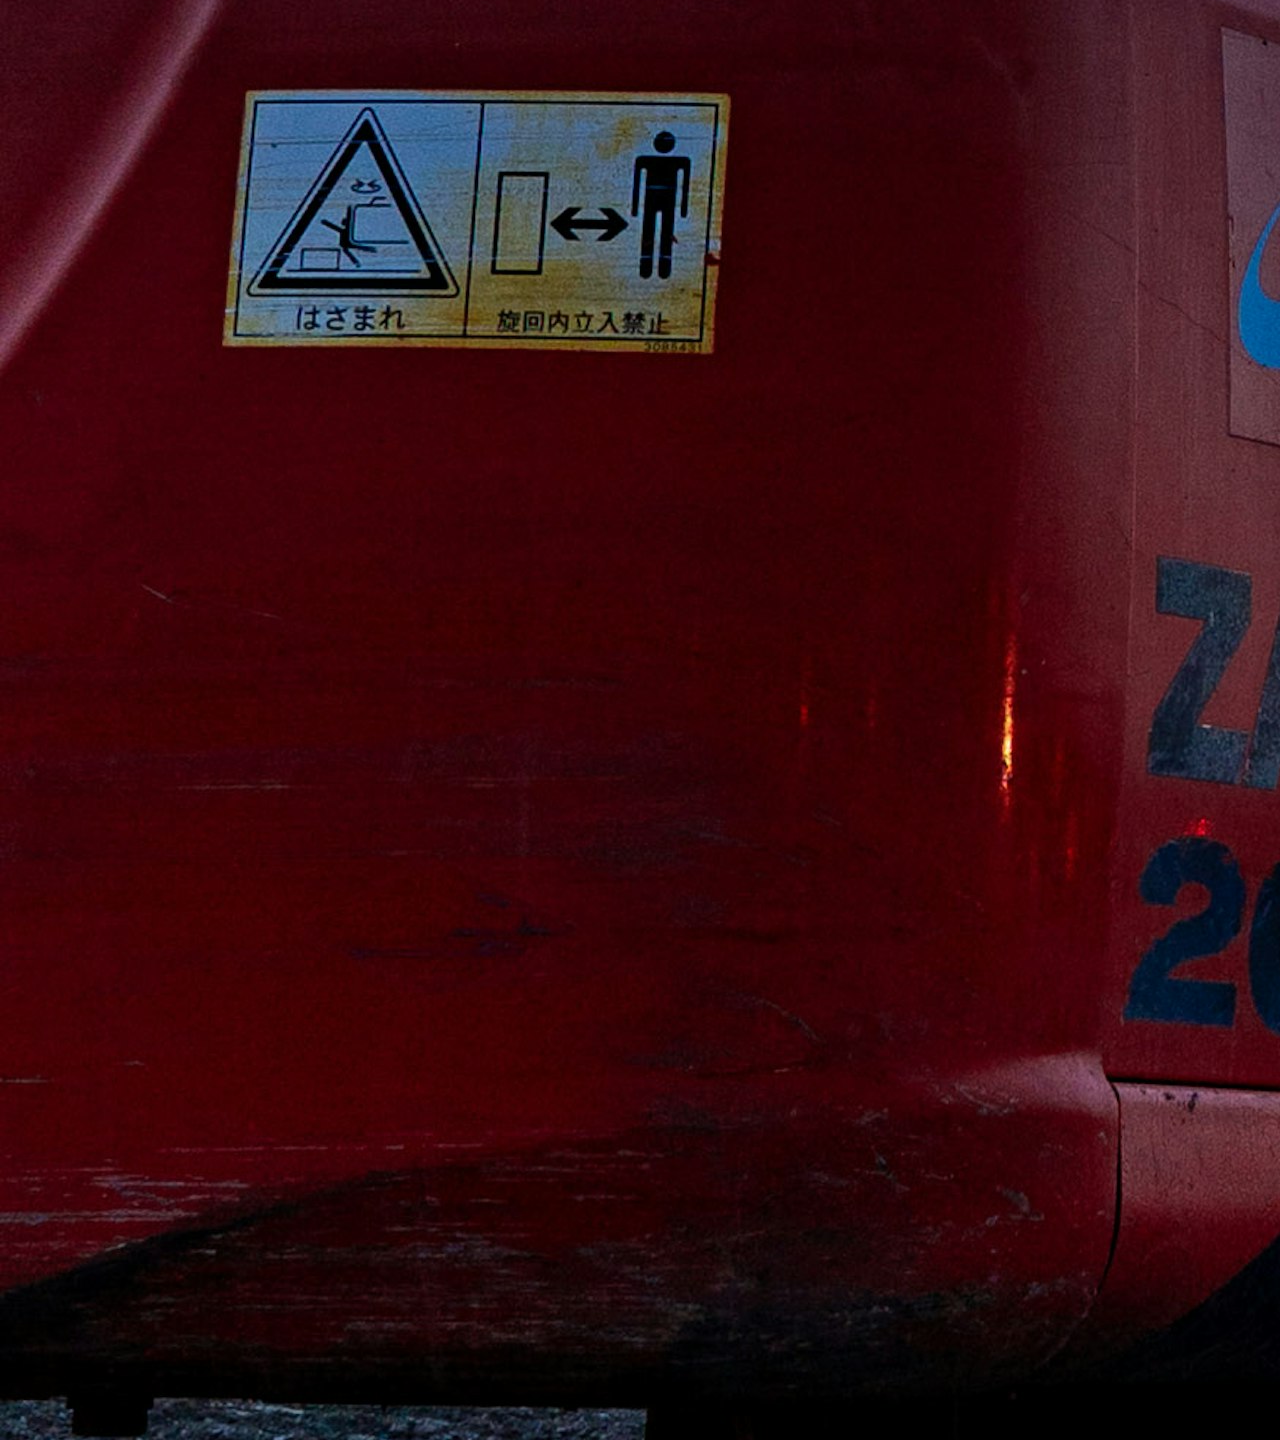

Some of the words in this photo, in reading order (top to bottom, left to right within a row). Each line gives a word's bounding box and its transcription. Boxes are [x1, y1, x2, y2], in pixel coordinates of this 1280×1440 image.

[297, 305, 406, 332] はさまれ
[497, 309, 670, 336] 旋回内立入禁止
